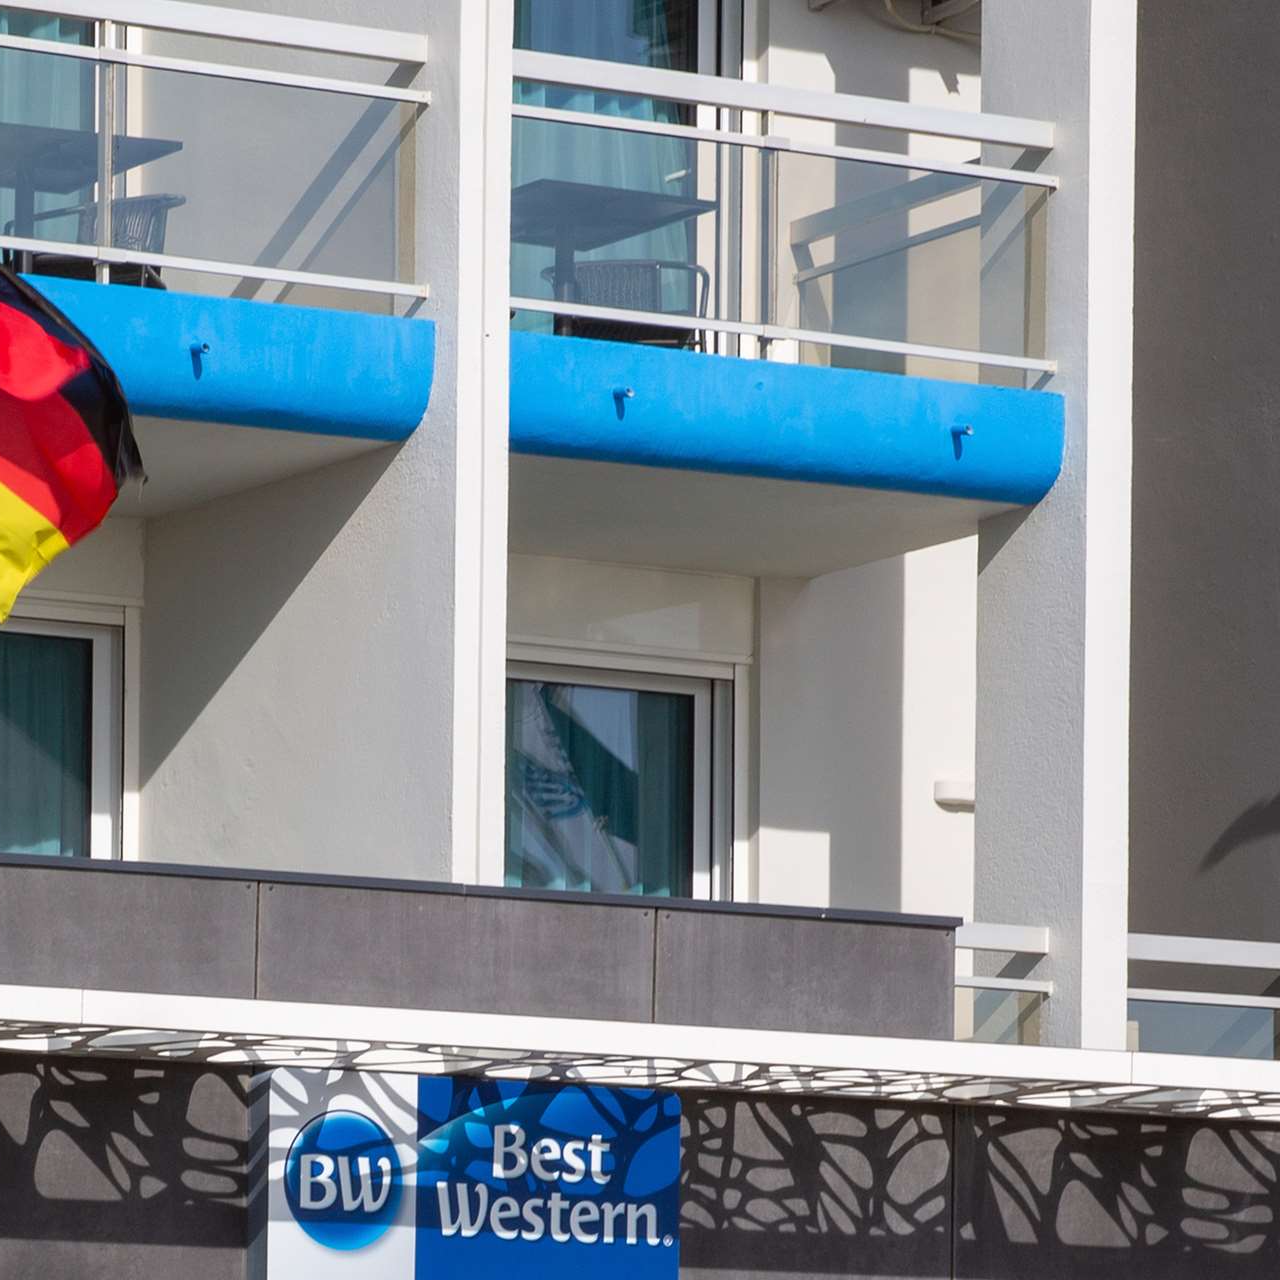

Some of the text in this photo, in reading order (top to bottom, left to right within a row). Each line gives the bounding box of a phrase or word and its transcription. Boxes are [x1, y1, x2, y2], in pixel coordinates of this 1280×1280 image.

[299, 1153, 392, 1213] BW
[491, 1124, 612, 1183] Best
[436, 1180, 661, 1247] Western
